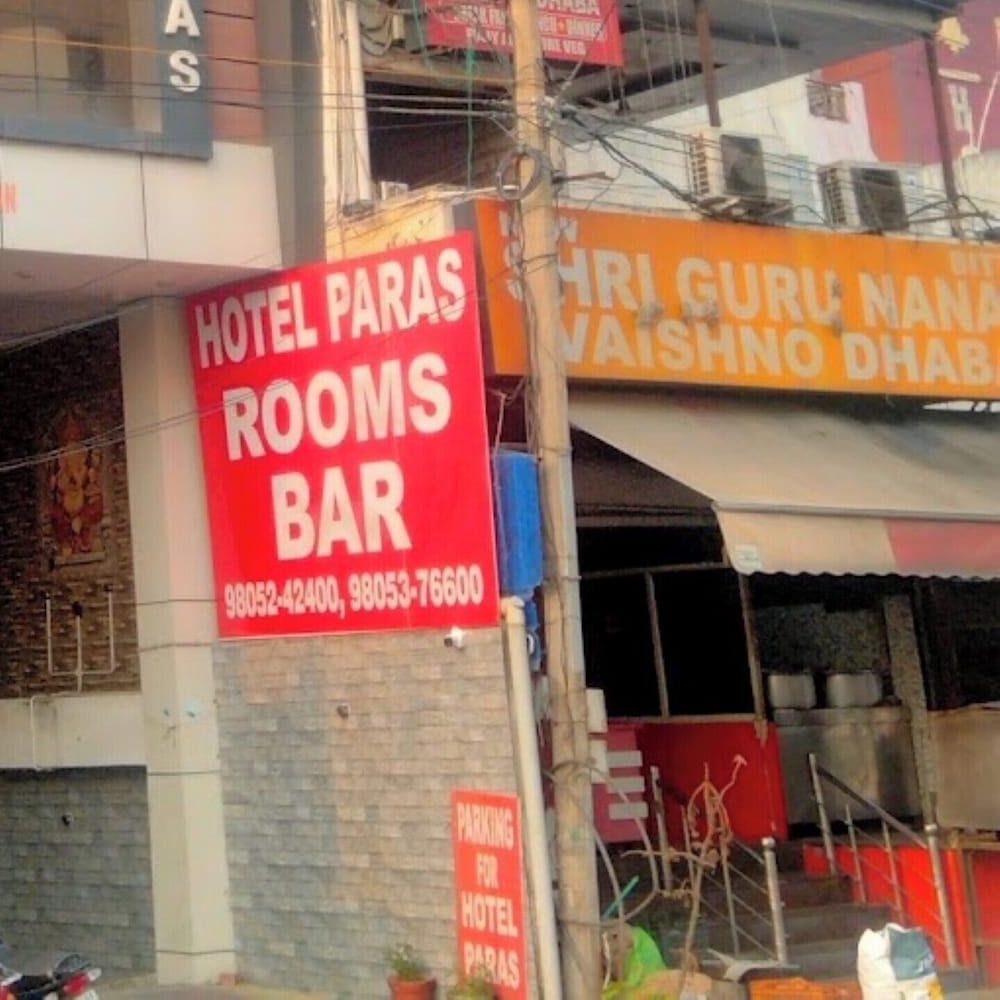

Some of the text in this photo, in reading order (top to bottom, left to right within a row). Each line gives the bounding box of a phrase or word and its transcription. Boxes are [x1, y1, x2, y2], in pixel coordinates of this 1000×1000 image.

[195, 247, 467, 369] HOTEL PARAS
[676, 256, 840, 325] GURU
[858, 271, 1000, 336] NANA
[556, 312, 823, 379] VAISHNO
[222, 352, 452, 462] ROOMS
[270, 460, 413, 561] BAR
[224, 564, 484, 620] 98052-42400, 98053-76600
[457, 802, 514, 850] PARKING
[475, 853, 499, 889] FOR
[461, 890, 518, 937] HOTEL
[464, 941, 520, 991] PARAS
